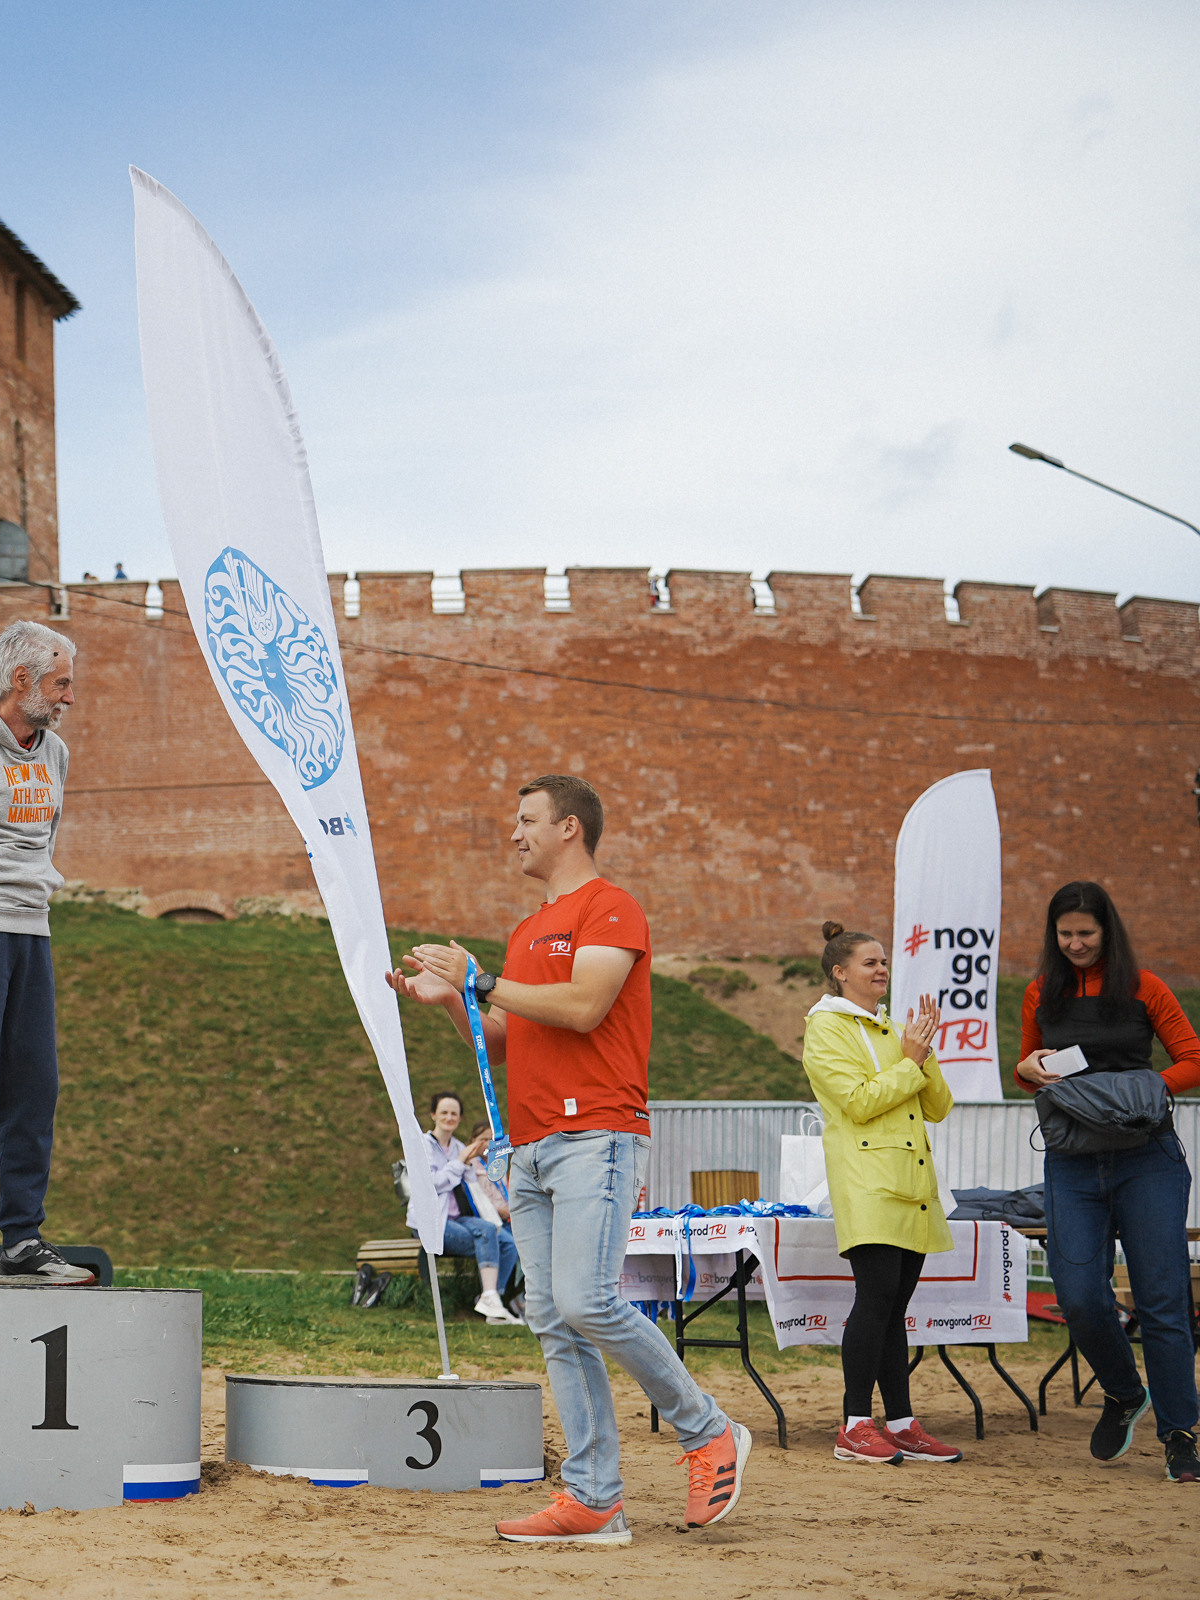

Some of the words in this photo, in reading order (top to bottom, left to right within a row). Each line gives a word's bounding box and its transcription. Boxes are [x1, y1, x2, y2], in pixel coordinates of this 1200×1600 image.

[3, 763, 30, 787] NEW
[905, 924, 994, 957] #nov
[30, 1324, 80, 1430] 1
[405, 1400, 442, 1470] 3
